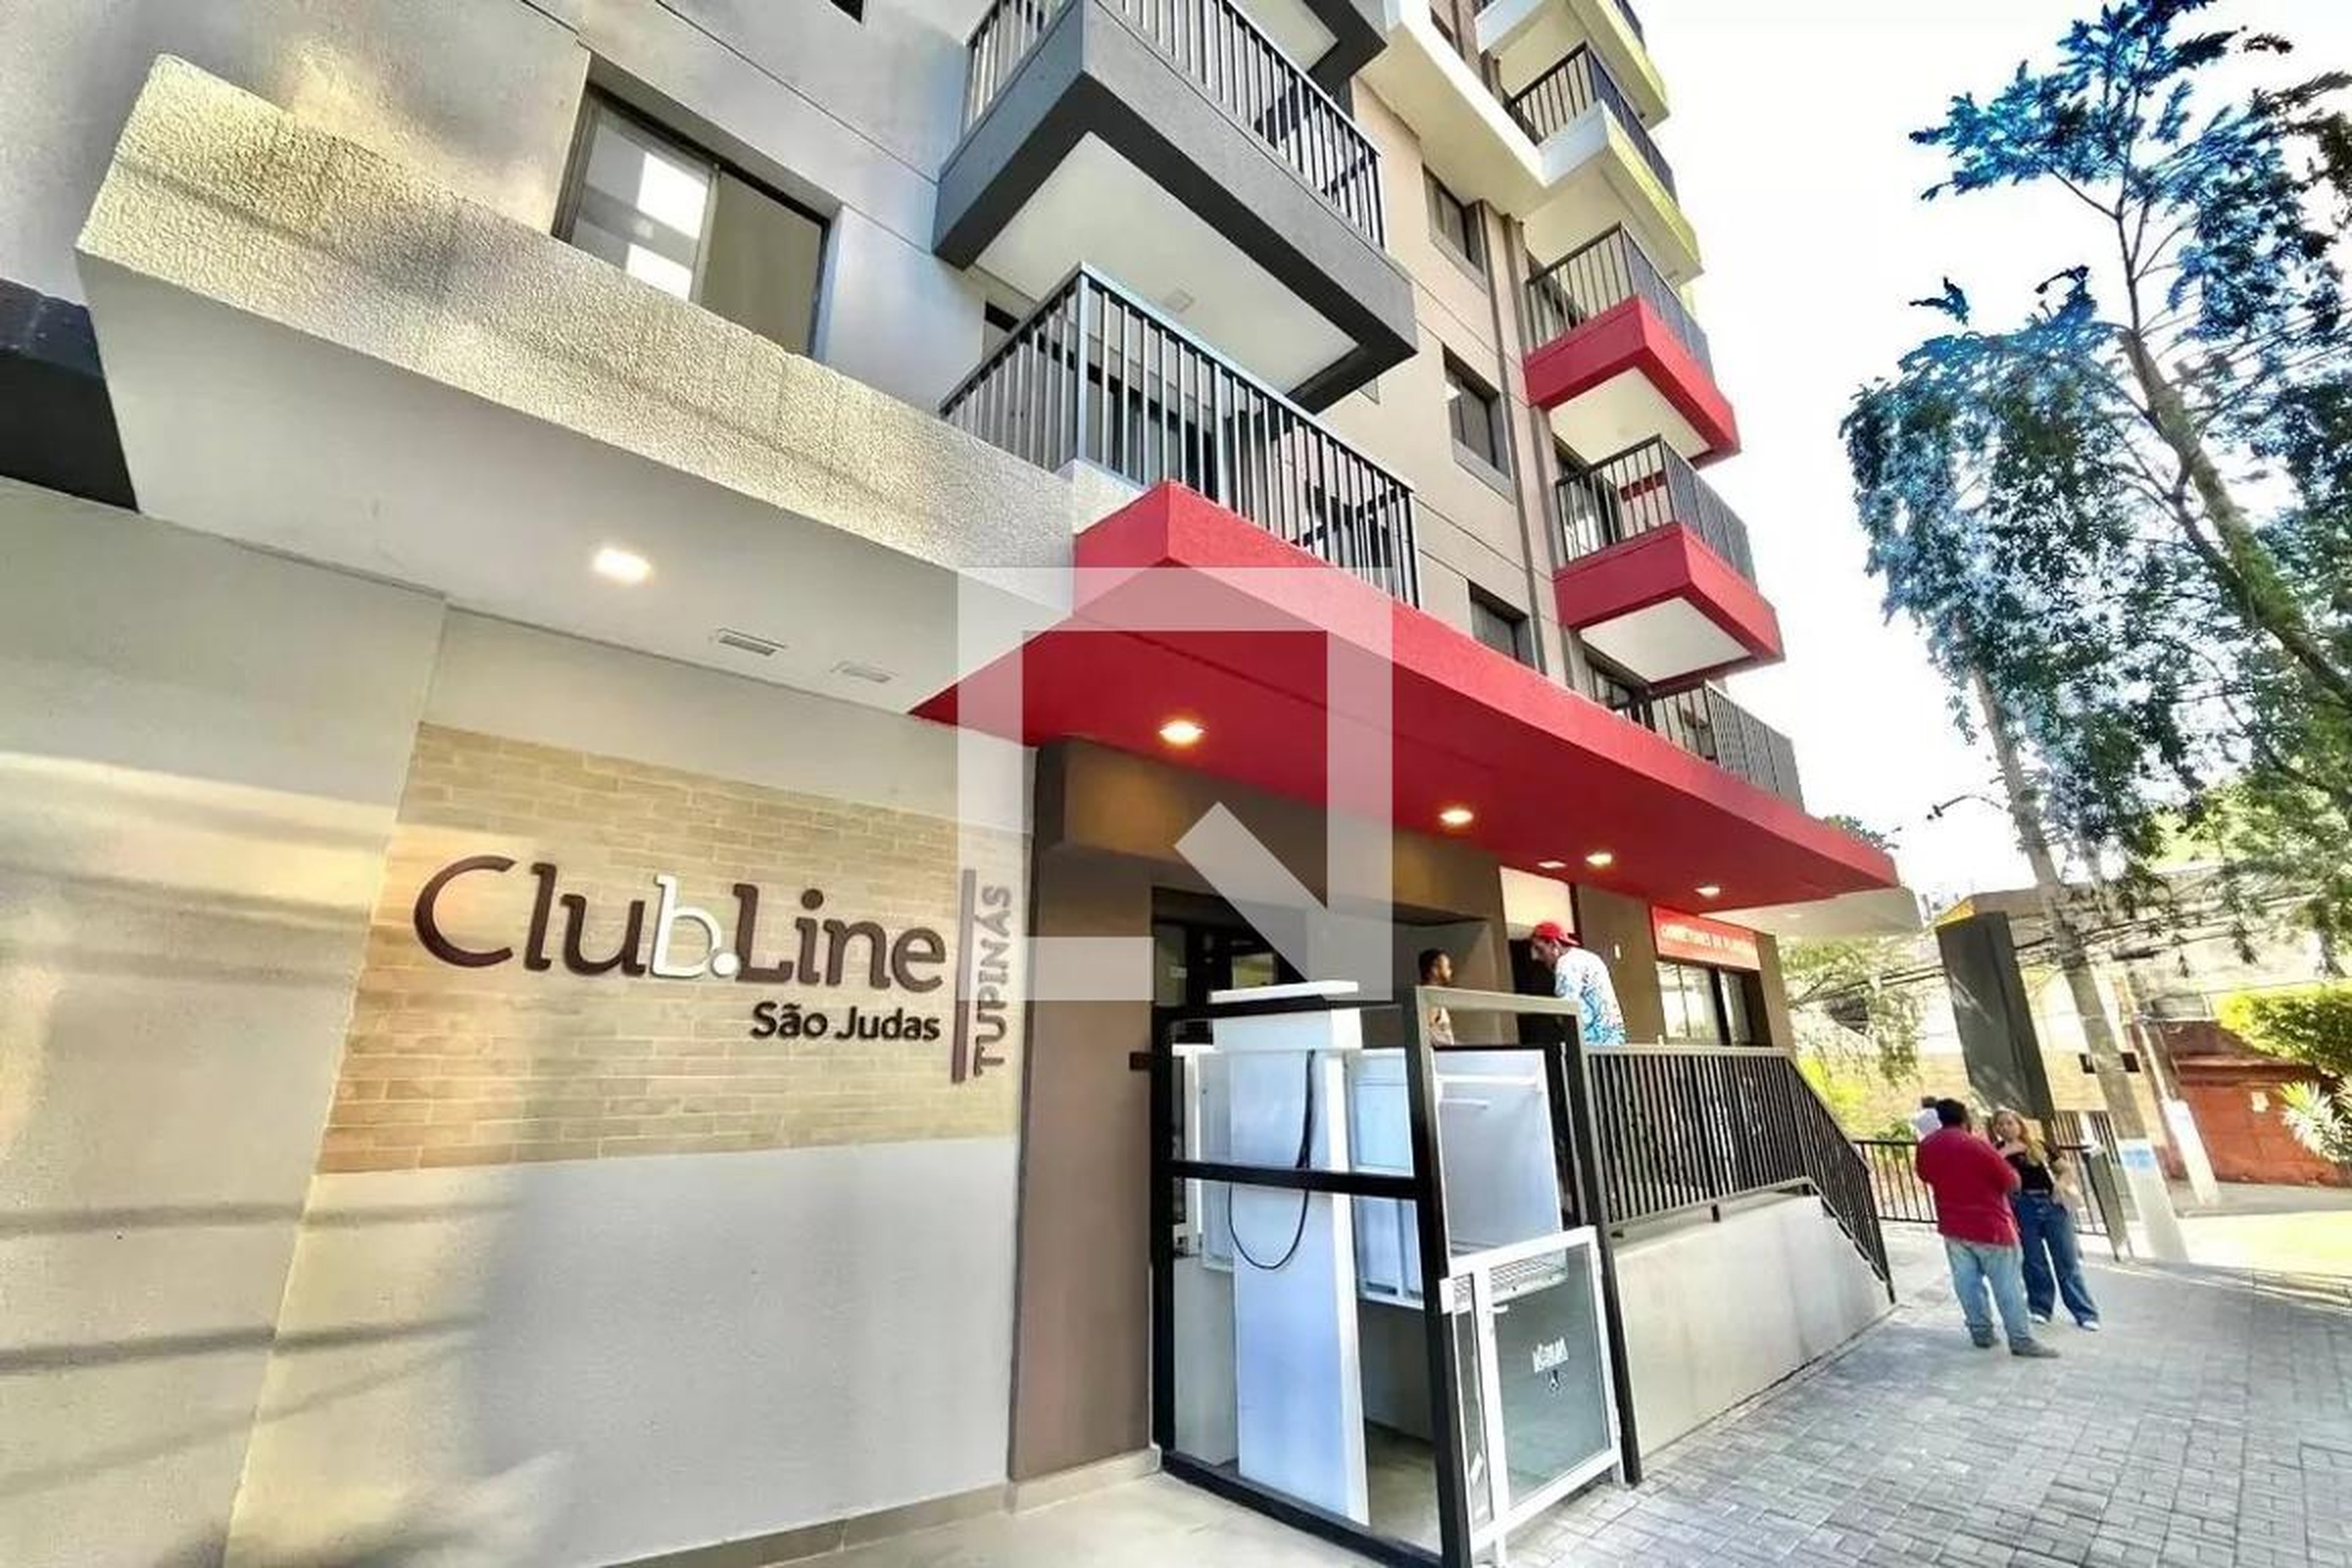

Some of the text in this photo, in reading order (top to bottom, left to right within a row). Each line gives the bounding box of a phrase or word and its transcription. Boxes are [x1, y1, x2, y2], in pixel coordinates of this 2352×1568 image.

[750, 1001, 941, 1041] São Judas
[974, 886, 1012, 1077] TUPINÁS
